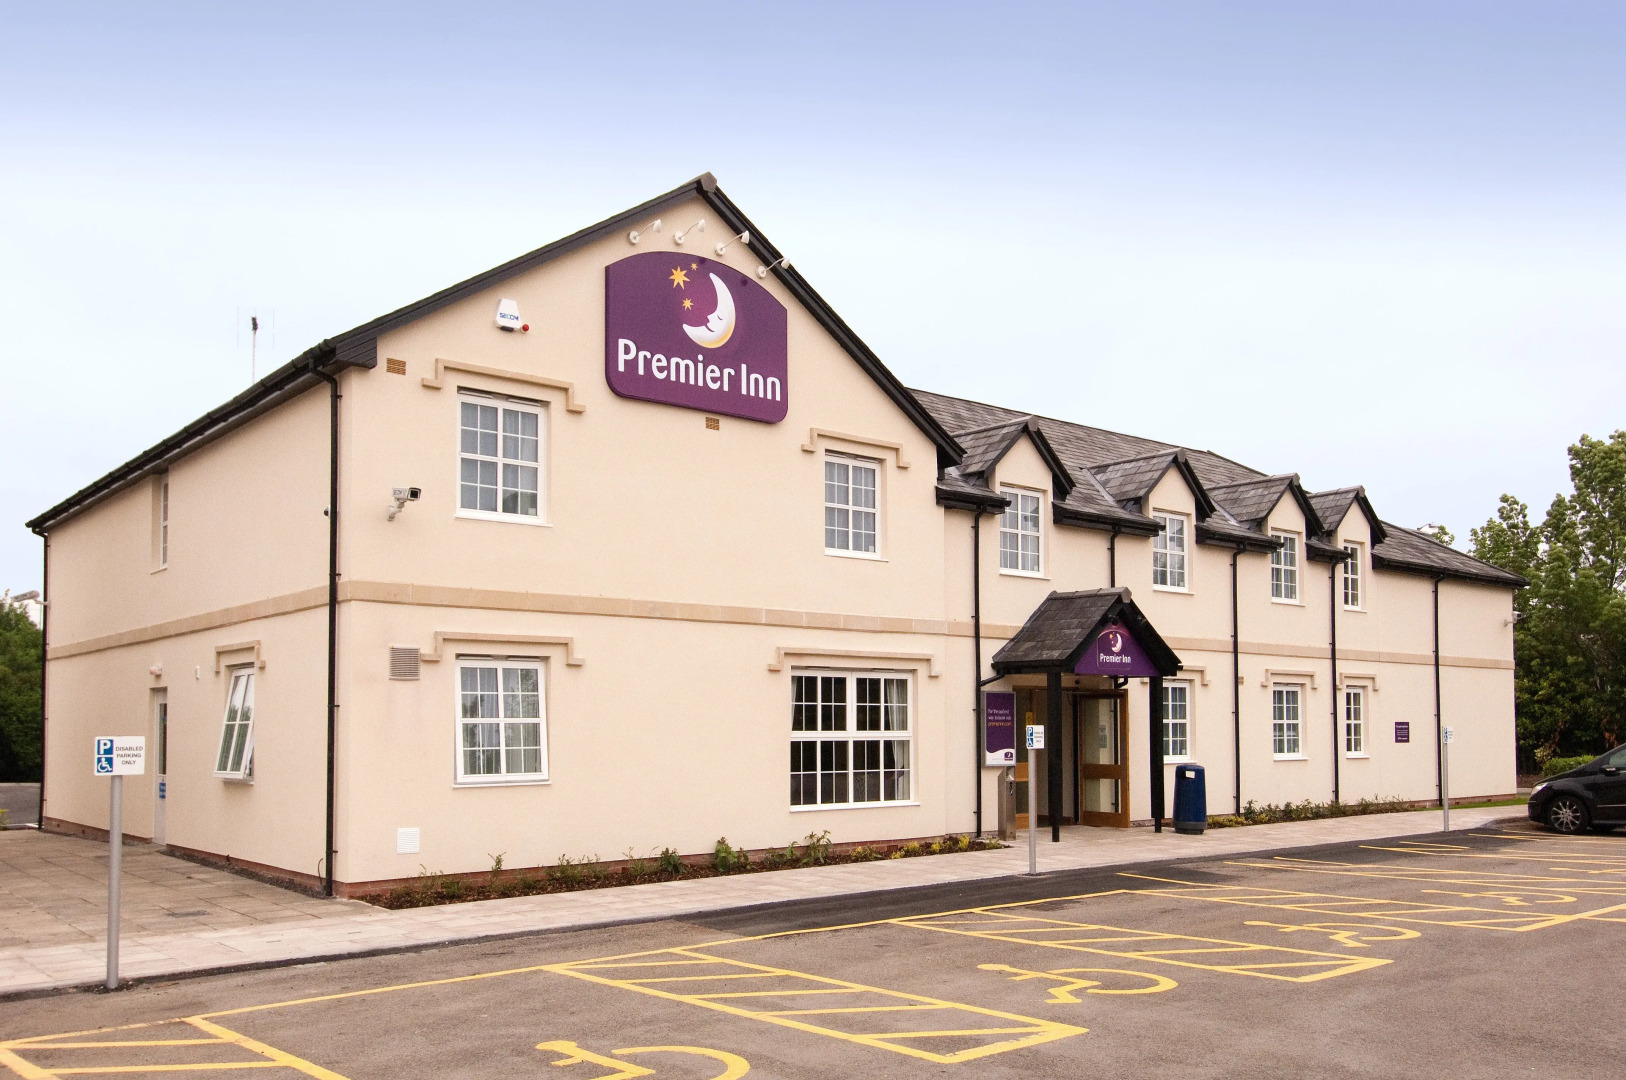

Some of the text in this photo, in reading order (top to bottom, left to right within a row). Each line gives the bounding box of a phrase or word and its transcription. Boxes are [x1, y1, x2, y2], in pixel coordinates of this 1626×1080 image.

[499, 312, 519, 321] SECOM
[618, 338, 781, 402] Premier Inn
[1100, 653, 1132, 664] Premier Inn
[99, 739, 111, 755] P
